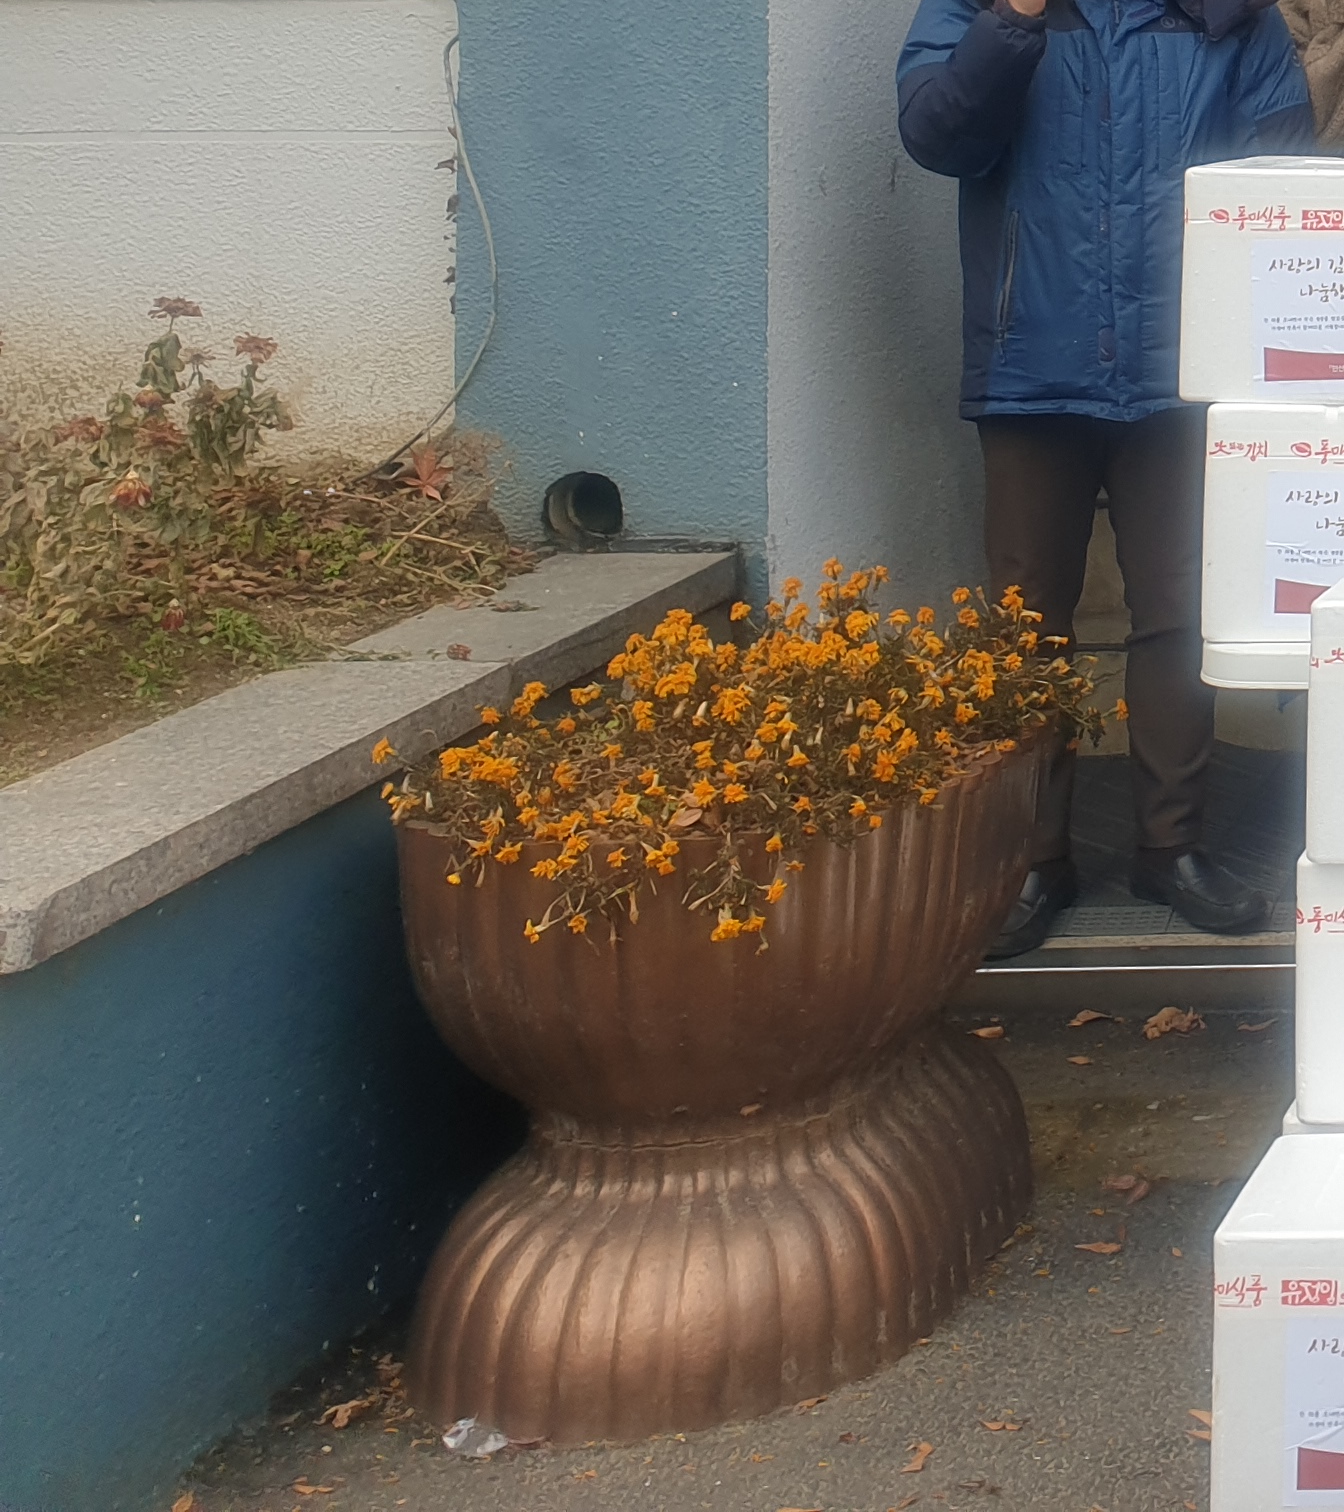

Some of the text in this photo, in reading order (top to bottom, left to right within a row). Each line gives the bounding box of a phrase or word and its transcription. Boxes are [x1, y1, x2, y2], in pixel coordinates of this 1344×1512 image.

[1231, 205, 1292, 232] 풍미식품
[1268, 254, 1320, 272] 사랑의
[1285, 489, 1338, 507] 사랑의
